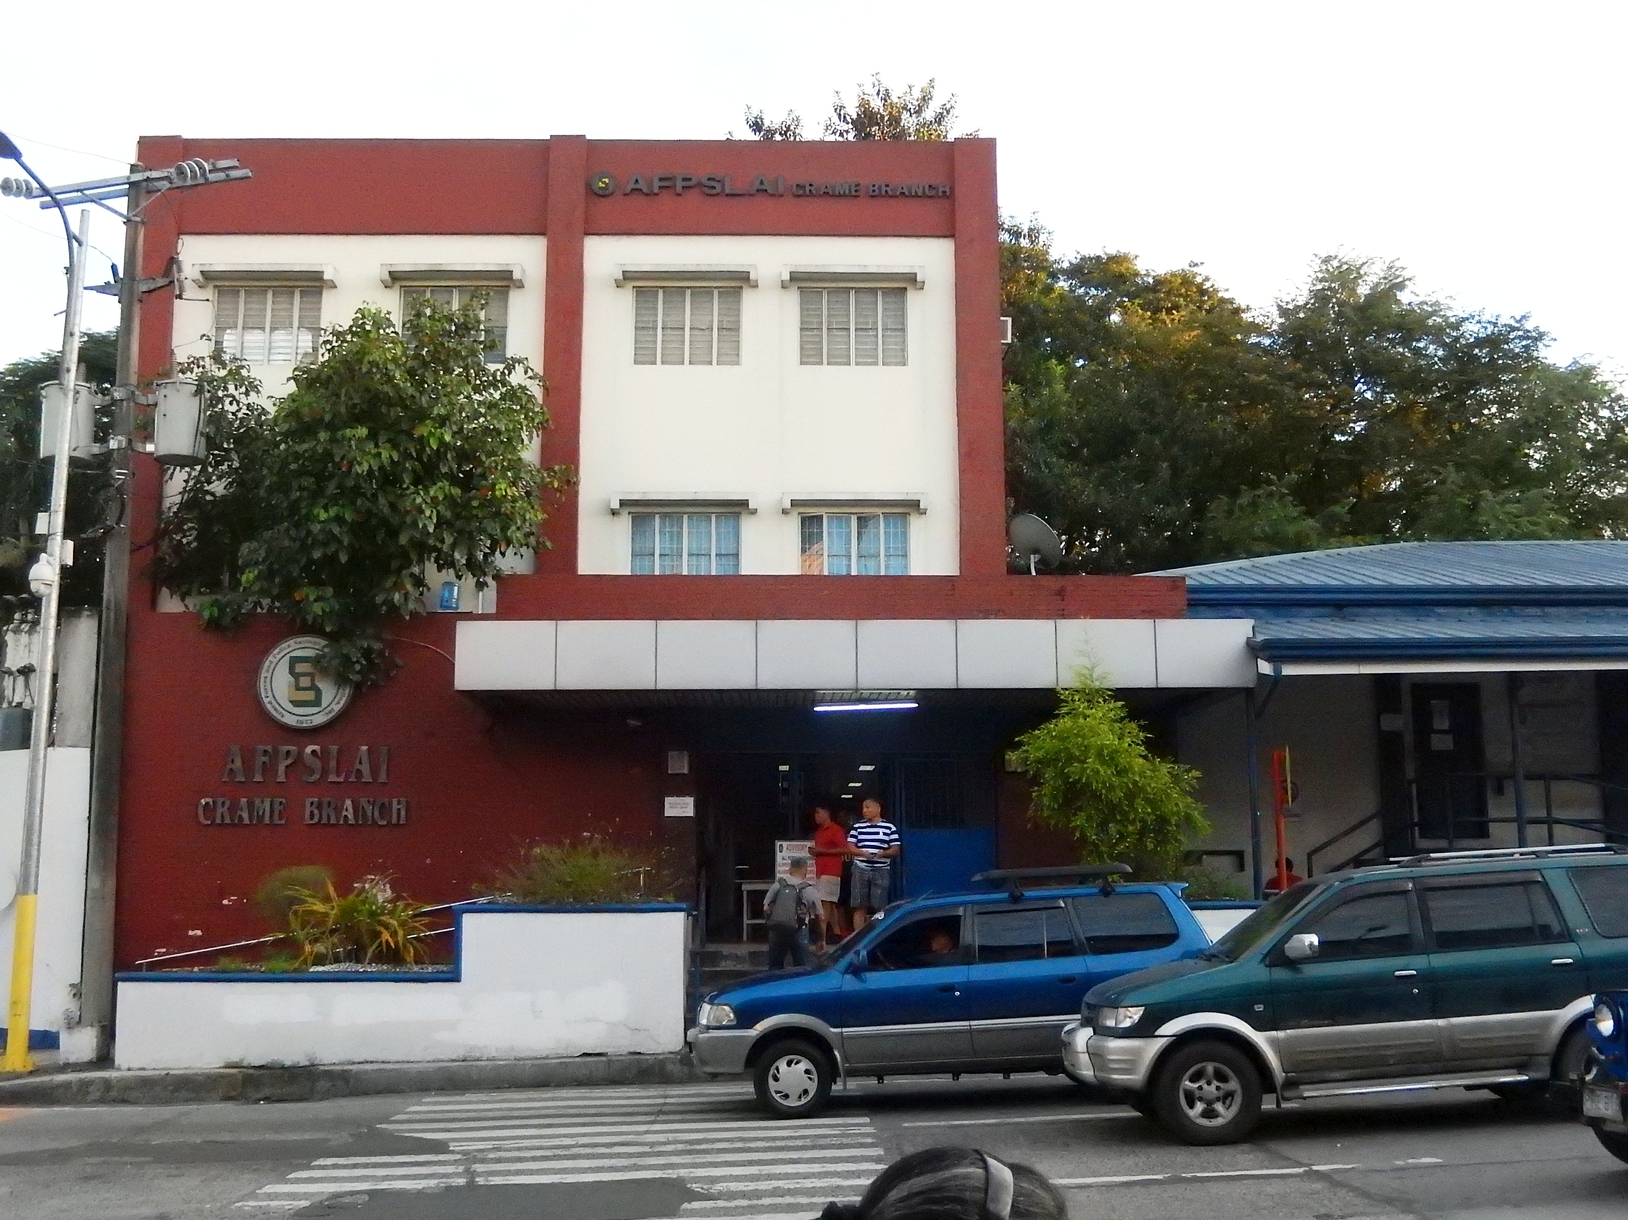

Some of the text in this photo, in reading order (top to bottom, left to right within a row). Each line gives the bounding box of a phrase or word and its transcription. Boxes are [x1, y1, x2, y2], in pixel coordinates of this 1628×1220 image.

[623, 173, 951, 198] AFPSLAI CRAME BRANCH
[221, 744, 390, 783] AFPSLAI
[197, 798, 407, 825] CRAME BRANCH
